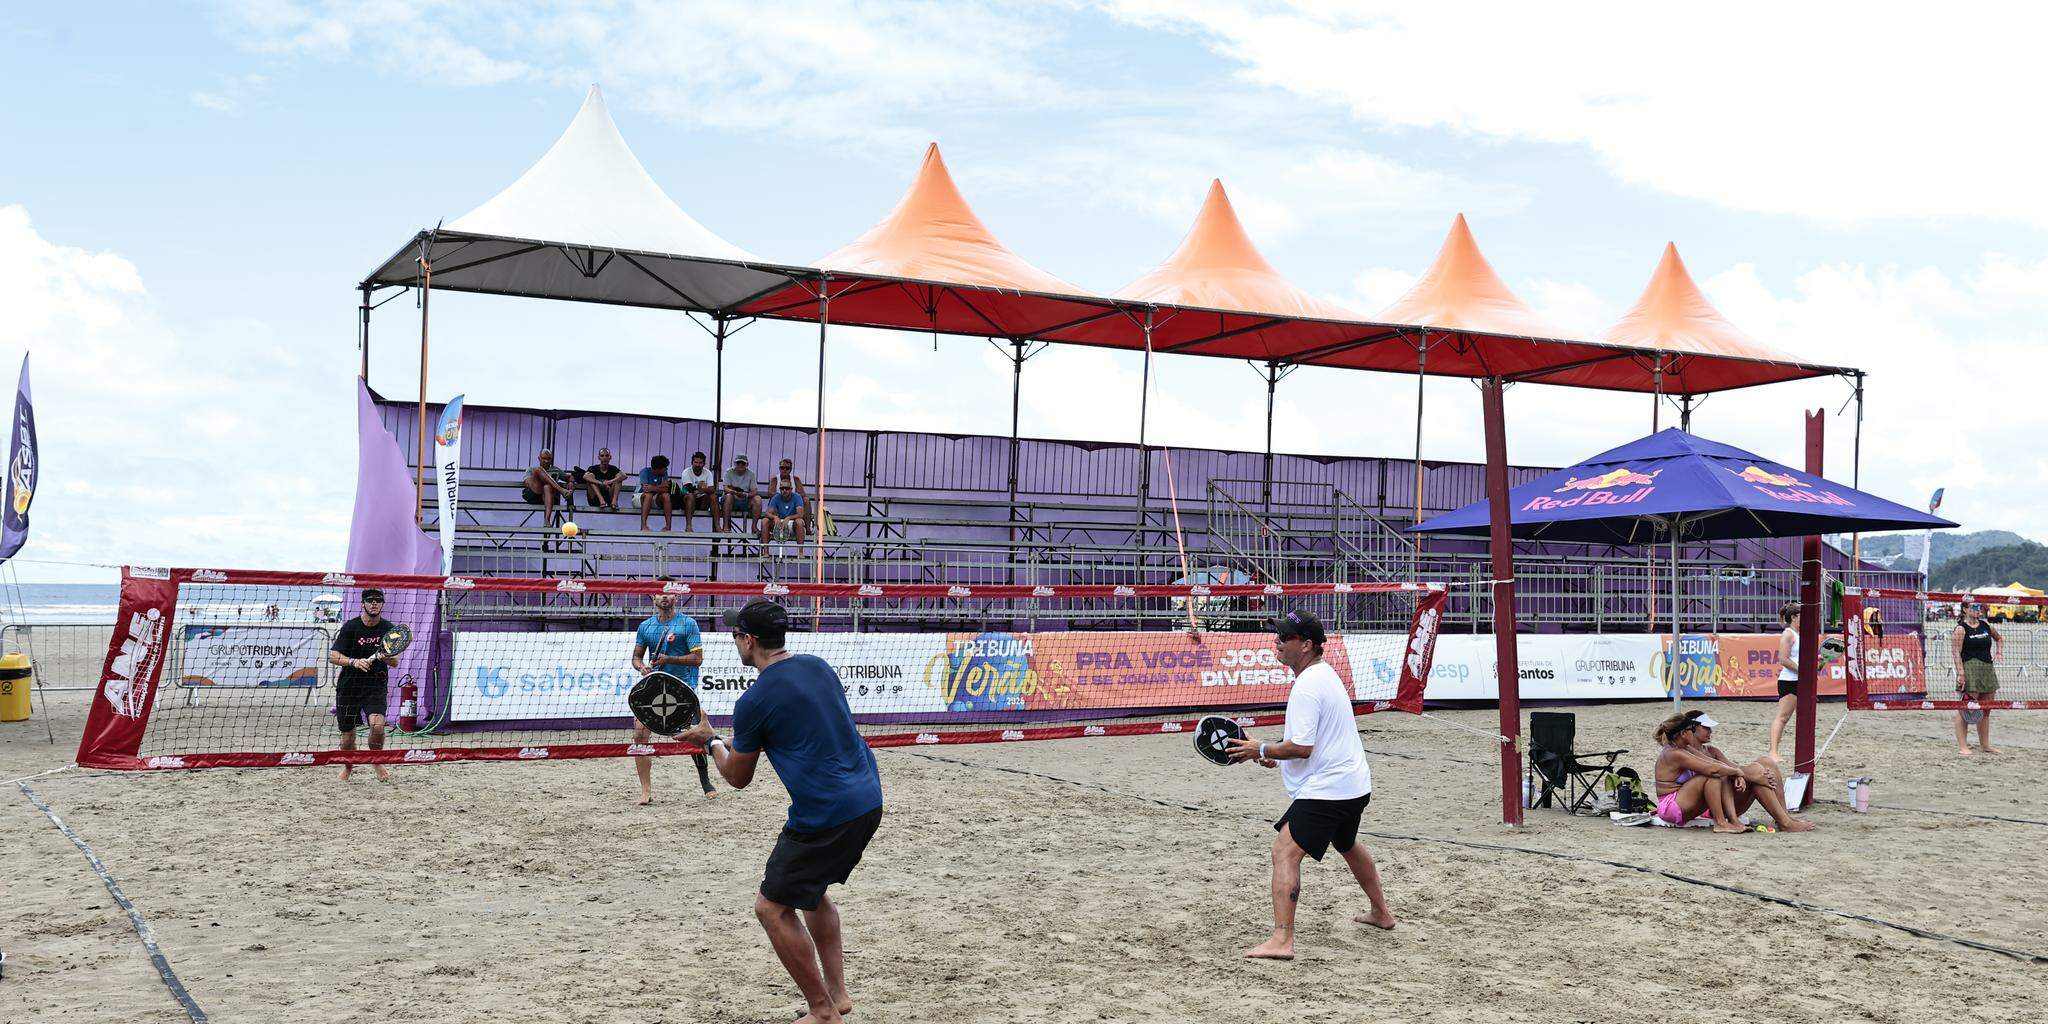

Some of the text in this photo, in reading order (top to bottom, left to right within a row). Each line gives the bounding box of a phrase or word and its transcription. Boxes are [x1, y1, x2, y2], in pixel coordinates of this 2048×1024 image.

[445, 461, 457, 520] IBUNA
[1521, 487, 1655, 511] Red Bull
[210, 645, 293, 656] GRUPOTRIBUNA
[953, 640, 1034, 657] TRIBUNA
[1076, 644, 1283, 669] PRA VOCÊ JOG
[146, 653, 157, 682] NACIONAL
[833, 665, 902, 679] OTRIBUNA
[1429, 662, 1469, 683] esp
[1517, 668, 1555, 679] antos
[1576, 660, 1636, 671] GRUPOTRIBUNA
[1649, 651, 1723, 692] Verão
[1749, 669, 1756, 678] E
[1759, 669, 1773, 678] SE
[1831, 662, 1907, 680] DIRSÃO
[520, 666, 633, 696] sabesp
[702, 675, 757, 690] Santo
[924, 648, 1037, 704] Verão
[1078, 676, 1087, 685] E
[1092, 675, 1113, 685] SE
[1174, 672, 1196, 684] NA
[1201, 666, 1296, 686] DIVERS
[892, 685, 903, 694] ge
